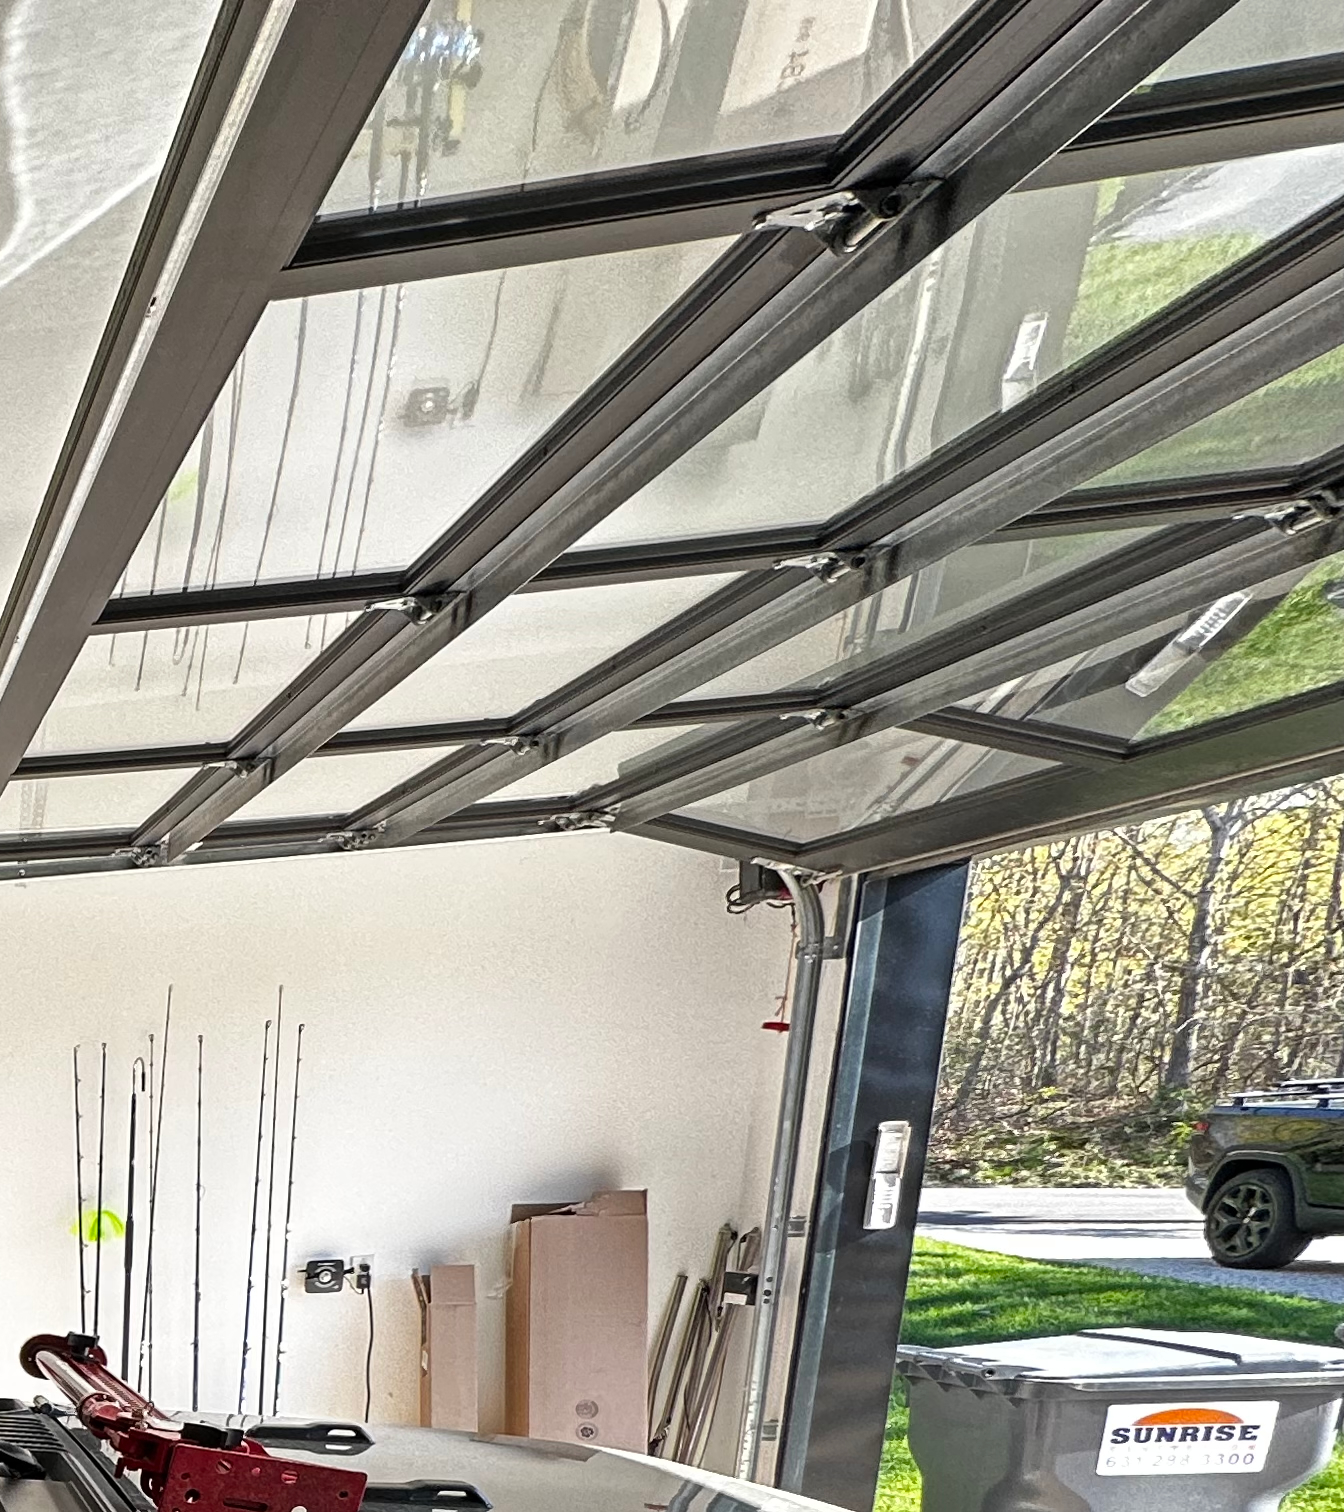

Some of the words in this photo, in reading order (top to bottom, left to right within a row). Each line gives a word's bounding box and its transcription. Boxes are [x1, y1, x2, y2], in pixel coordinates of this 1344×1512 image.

[1109, 1424, 1261, 1445] SUNRISE
[1152, 1454, 1191, 1467] 298
[1199, 1452, 1256, 1467] 3300
